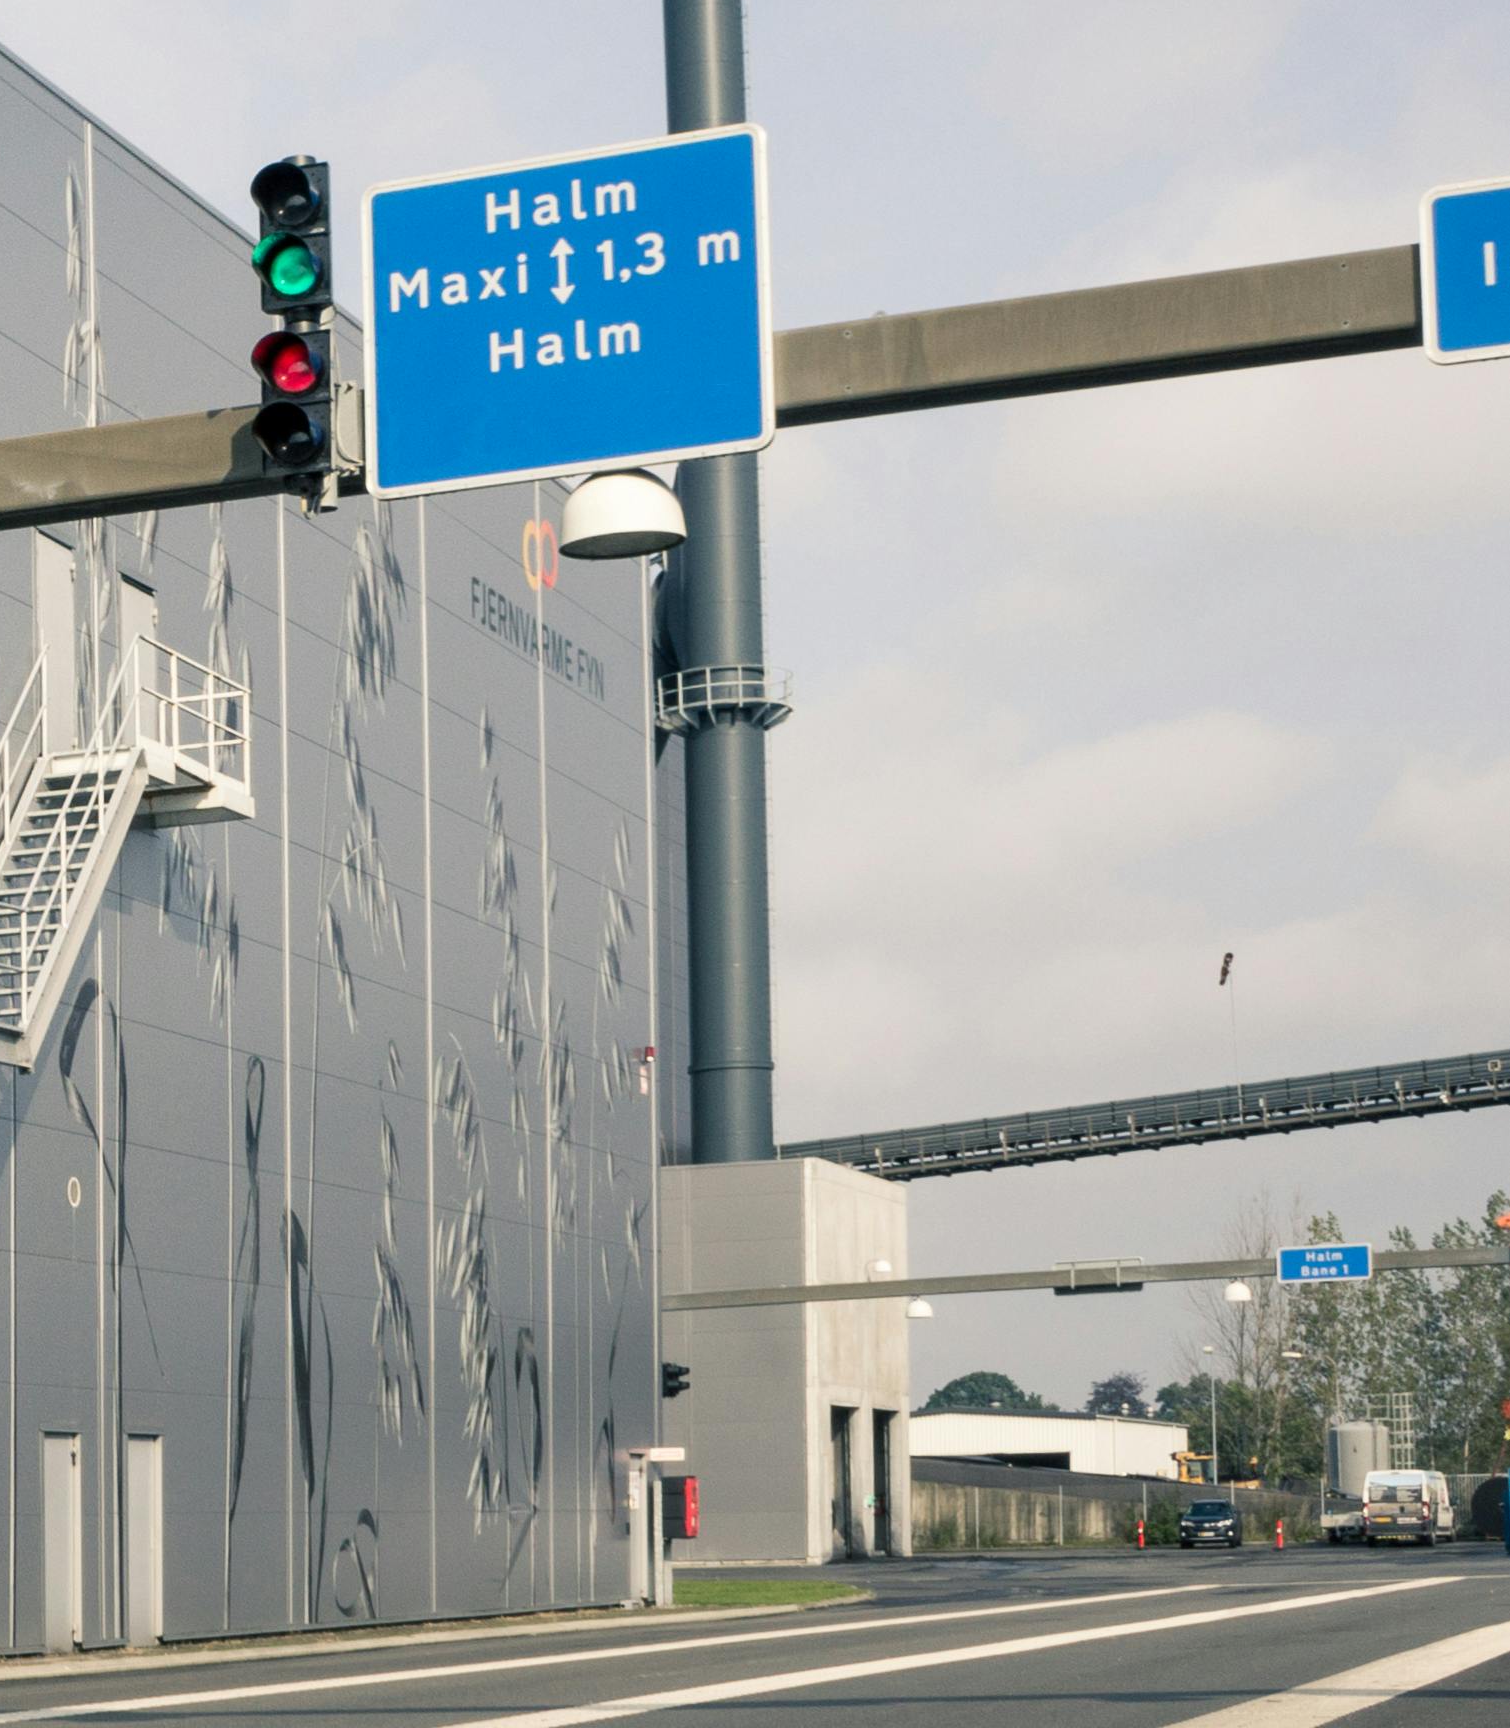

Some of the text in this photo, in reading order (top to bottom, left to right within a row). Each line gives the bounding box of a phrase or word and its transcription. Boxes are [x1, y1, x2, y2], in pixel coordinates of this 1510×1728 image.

[485, 178, 636, 234] Halm
[389, 230, 740, 313] Maxi 1,3 m
[489, 319, 641, 373] Halm
[471, 577, 605, 702] FJERNVARME FYN
[1301, 1264, 1350, 1277] Bane 1
[1305, 1251, 1343, 1262] Halm
